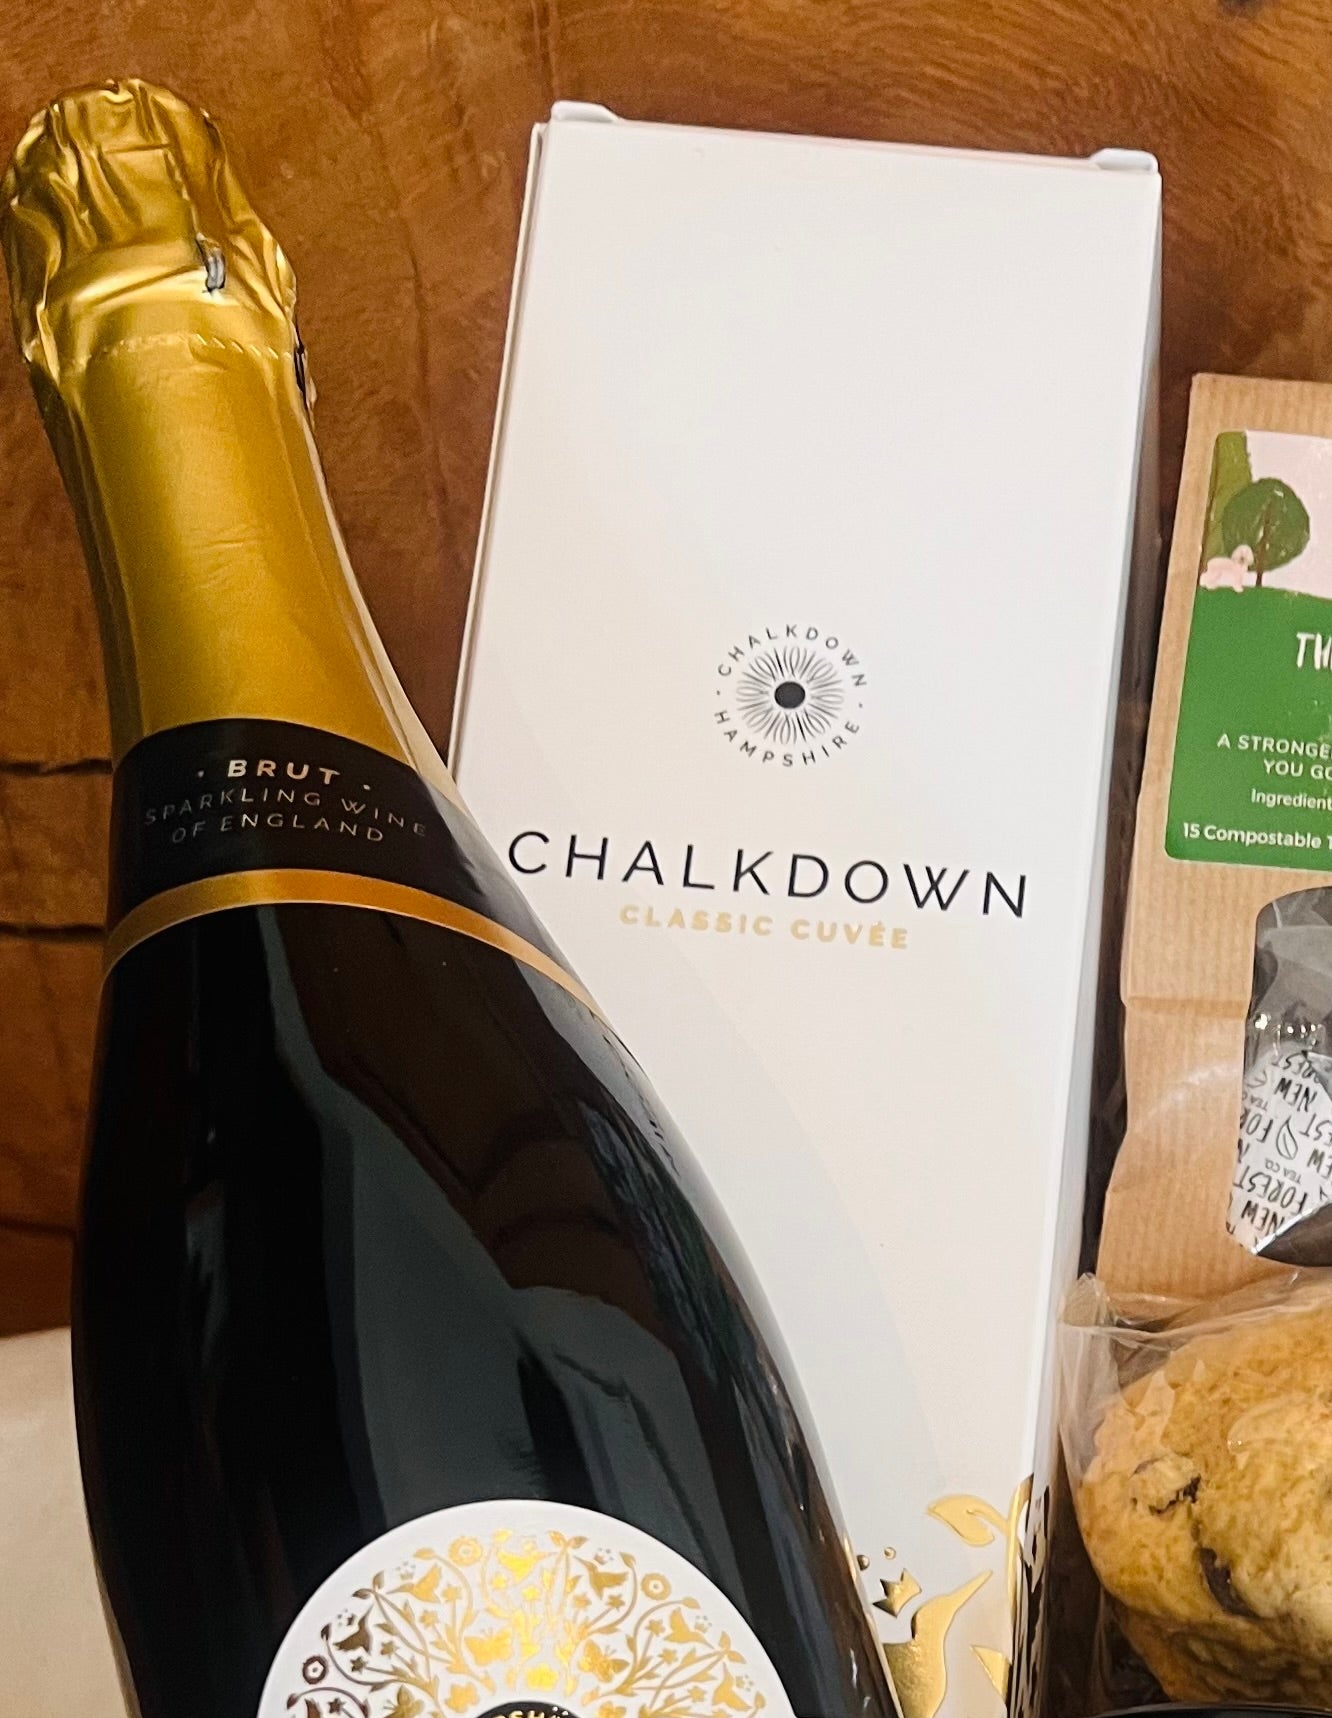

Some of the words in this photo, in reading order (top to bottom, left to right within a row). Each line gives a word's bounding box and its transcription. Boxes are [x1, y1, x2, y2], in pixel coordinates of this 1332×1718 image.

[717, 623, 868, 688] CHALKDOWN
[714, 709, 860, 767] HAMPSHIRE
[1216, 733, 1231, 749] A
[227, 759, 341, 786] BRUT
[1263, 759, 1304, 777] YOU
[144, 788, 322, 827] SPARKLING
[341, 797, 427, 838] WINE
[171, 820, 205, 844] OF
[219, 811, 384, 843] ENGLAND
[1183, 822, 1201, 839] 15
[1203, 824, 1322, 850] Compostable
[507, 830, 1028, 919] CHALKDOWN
[619, 903, 773, 936] CLASSIC
[791, 919, 909, 949] CUVÉE
